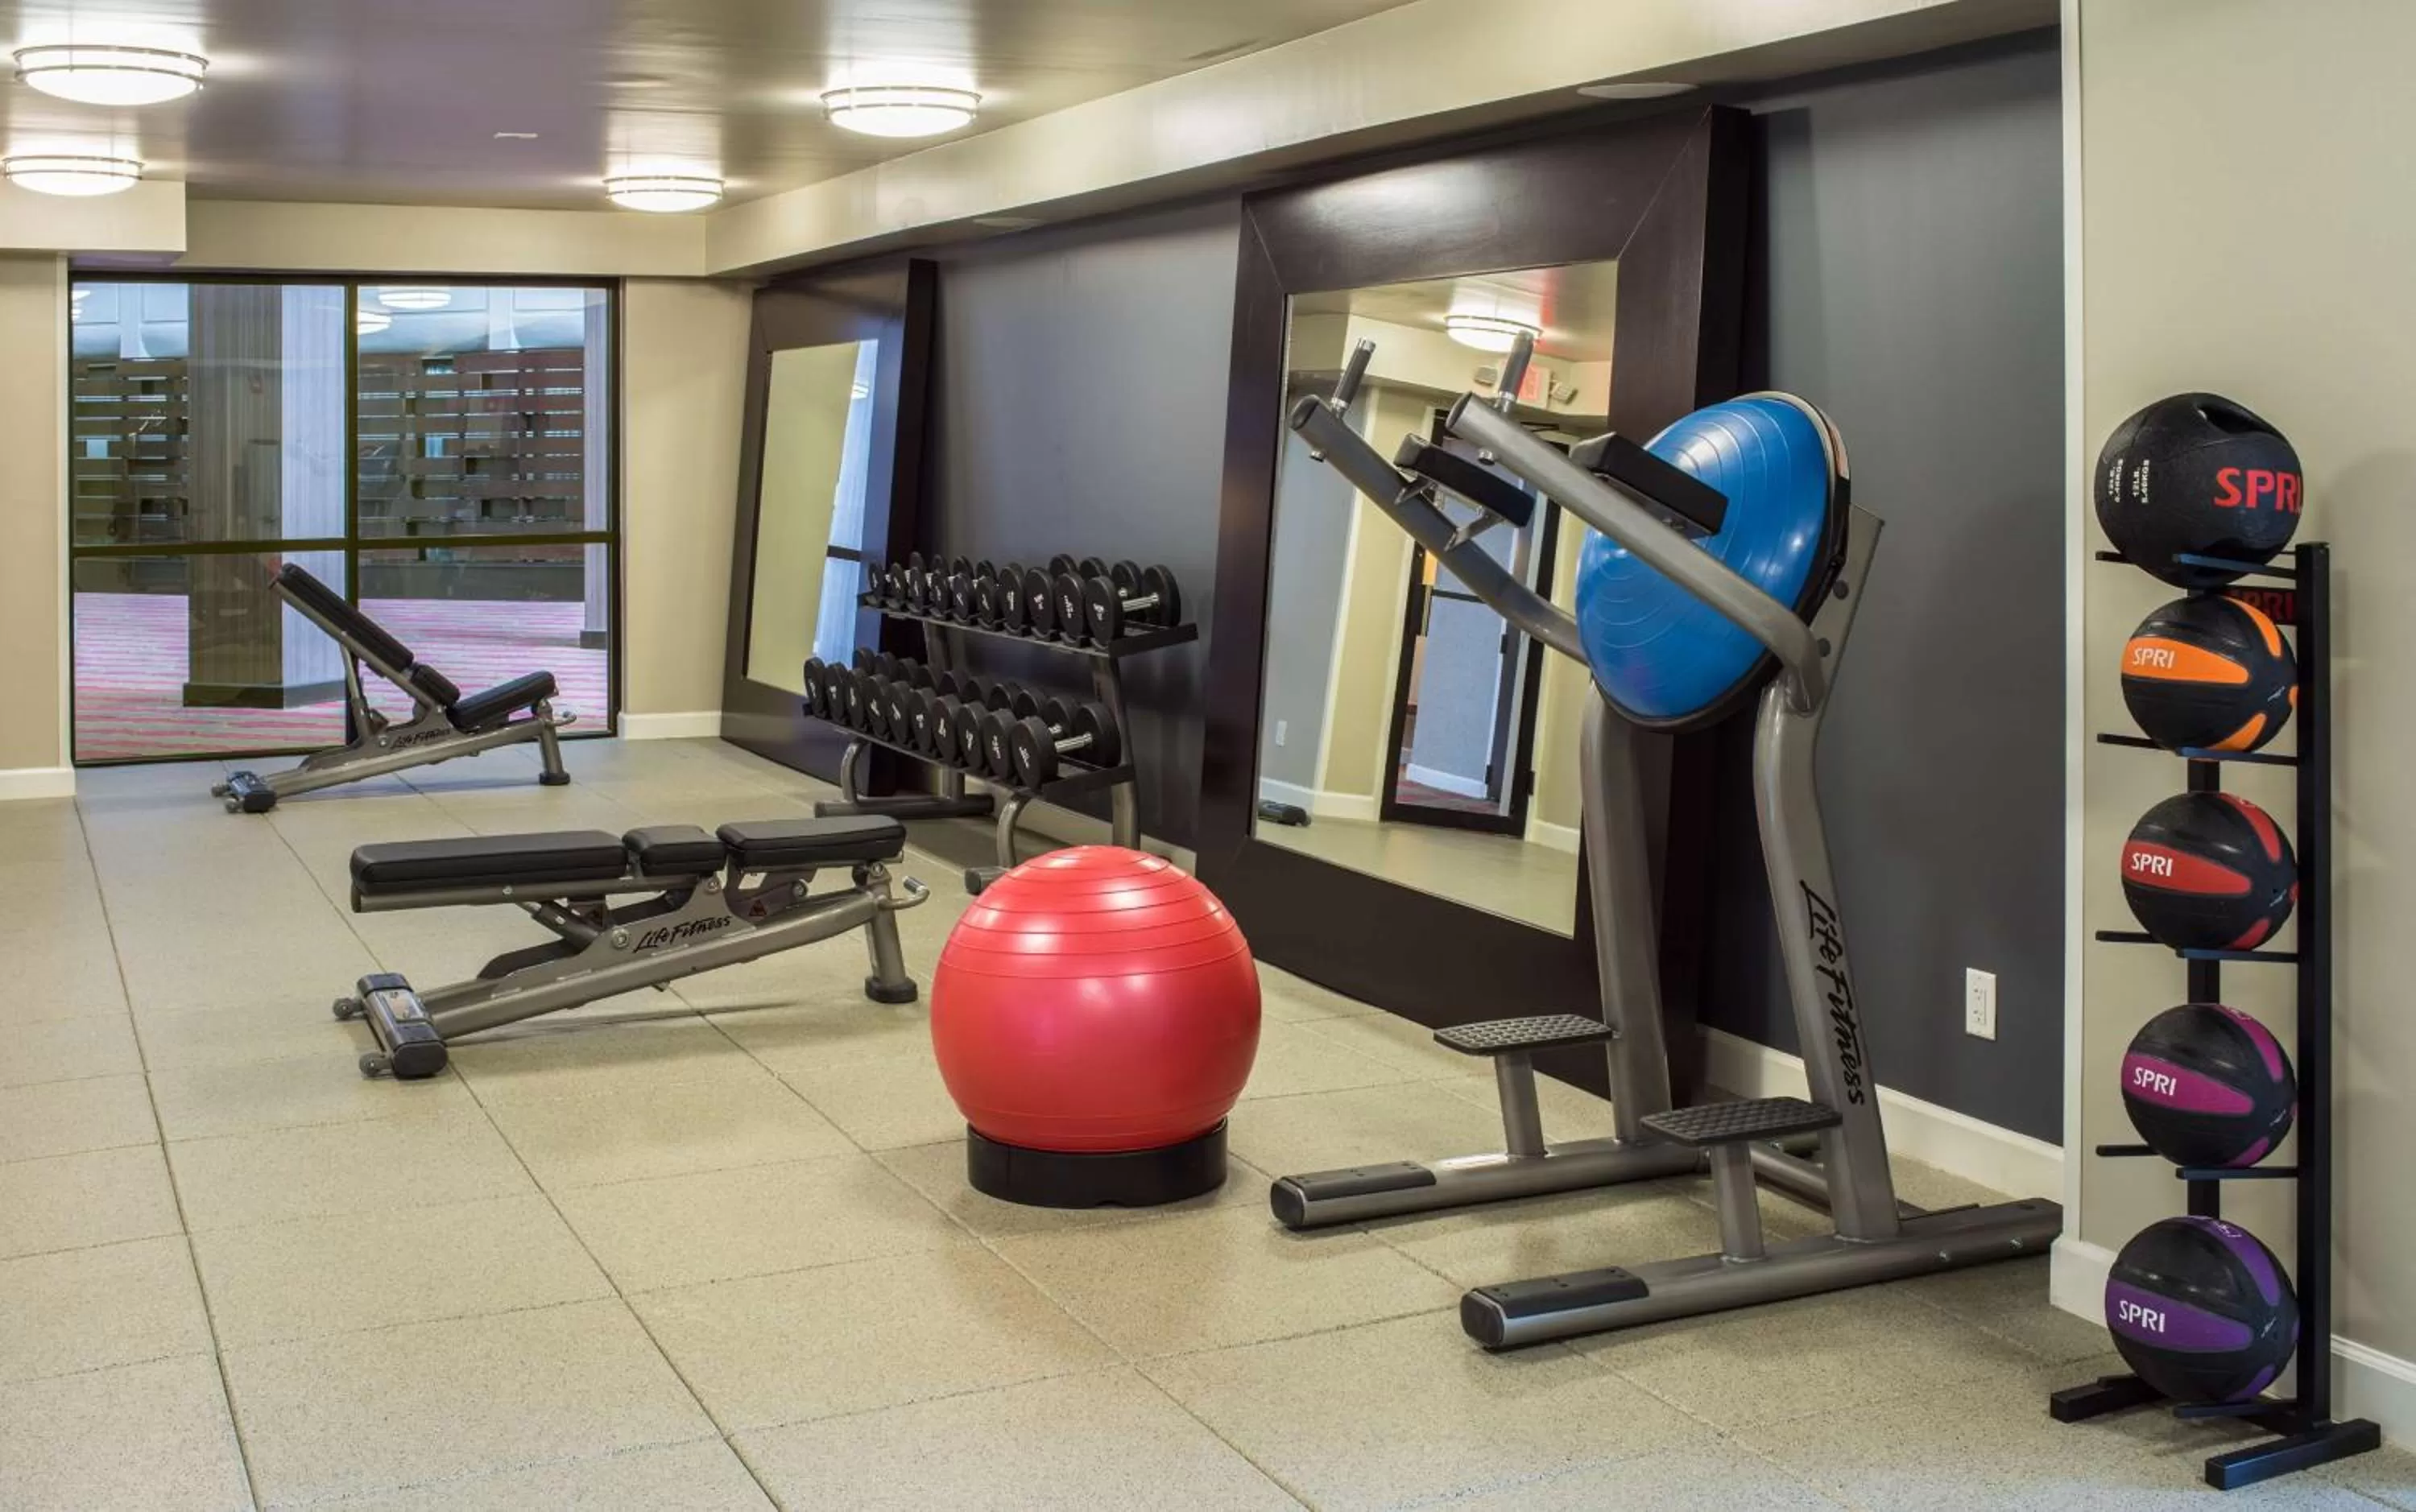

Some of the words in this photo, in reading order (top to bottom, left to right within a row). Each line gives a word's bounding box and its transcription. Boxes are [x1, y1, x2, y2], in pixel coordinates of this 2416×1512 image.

[2132, 647, 2175, 669] SPRI
[2131, 852, 2173, 877] SPRI
[669, 915, 732, 945] Fitness
[1799, 879, 1844, 965] Life
[1815, 965, 1865, 1106] Fitness
[2133, 1066, 2176, 1096] SPRI
[2119, 1299, 2166, 1333] SPRI
